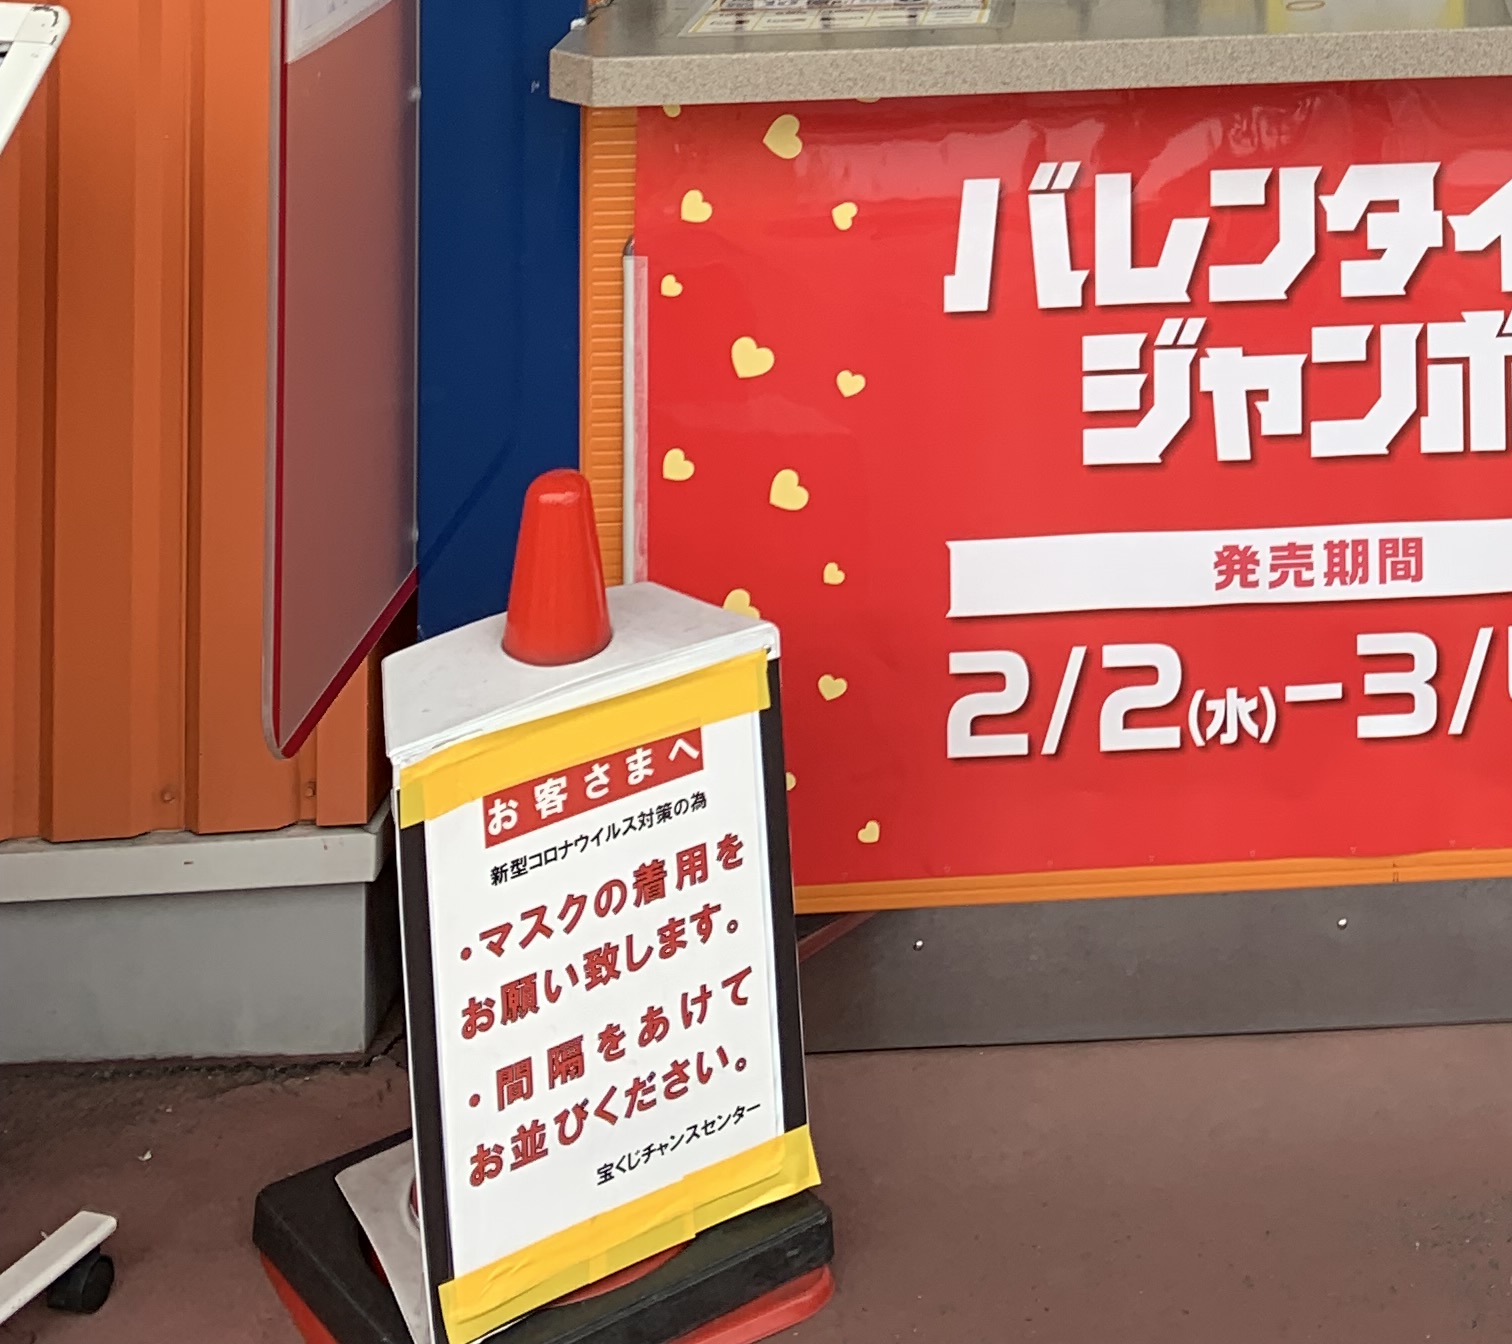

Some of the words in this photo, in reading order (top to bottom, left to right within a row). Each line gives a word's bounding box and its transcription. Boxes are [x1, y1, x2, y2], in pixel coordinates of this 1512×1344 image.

[1213, 537, 1424, 590] 発売期間
[486, 739, 700, 836] お客さまへ
[490, 791, 707, 886] 新型コロナウイルス対策の為
[461, 903, 739, 1040] お願い致します。
[469, 1044, 747, 1187] お並びください。
[597, 1103, 761, 1185] 宝くじチャンスセンター
